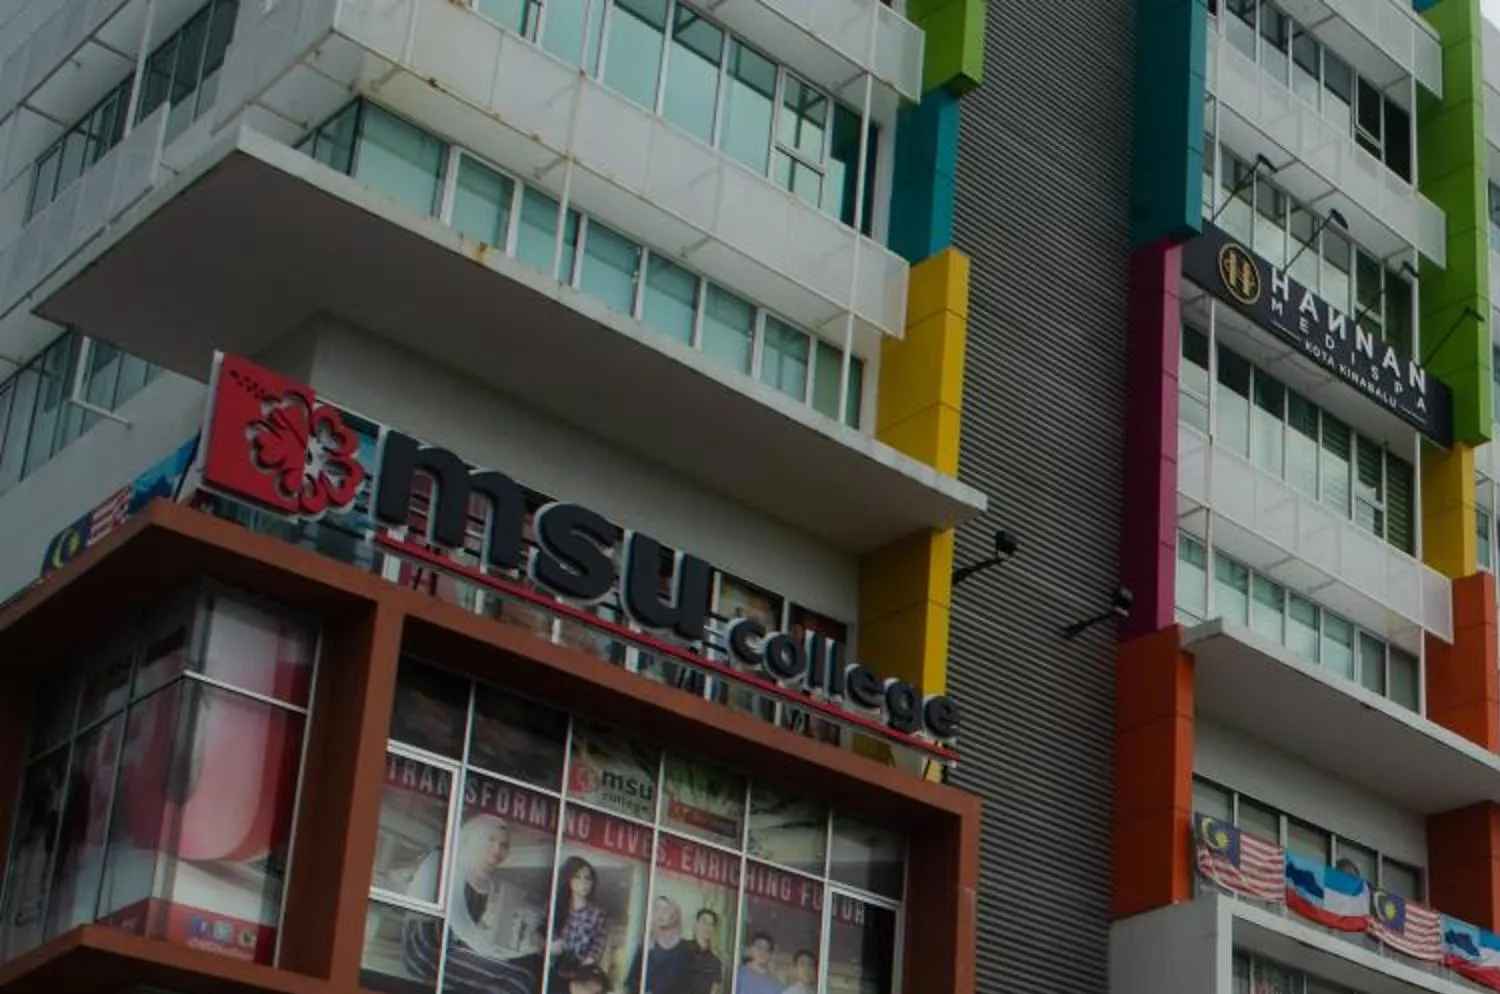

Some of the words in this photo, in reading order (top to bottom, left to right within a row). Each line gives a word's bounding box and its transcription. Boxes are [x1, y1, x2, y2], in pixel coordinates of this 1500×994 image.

[1305, 339, 1335, 368] KOTA
[1339, 363, 1397, 408] KINABALU
[374, 428, 712, 640] msu
[724, 616, 960, 741] college
[601, 769, 653, 800] msu
